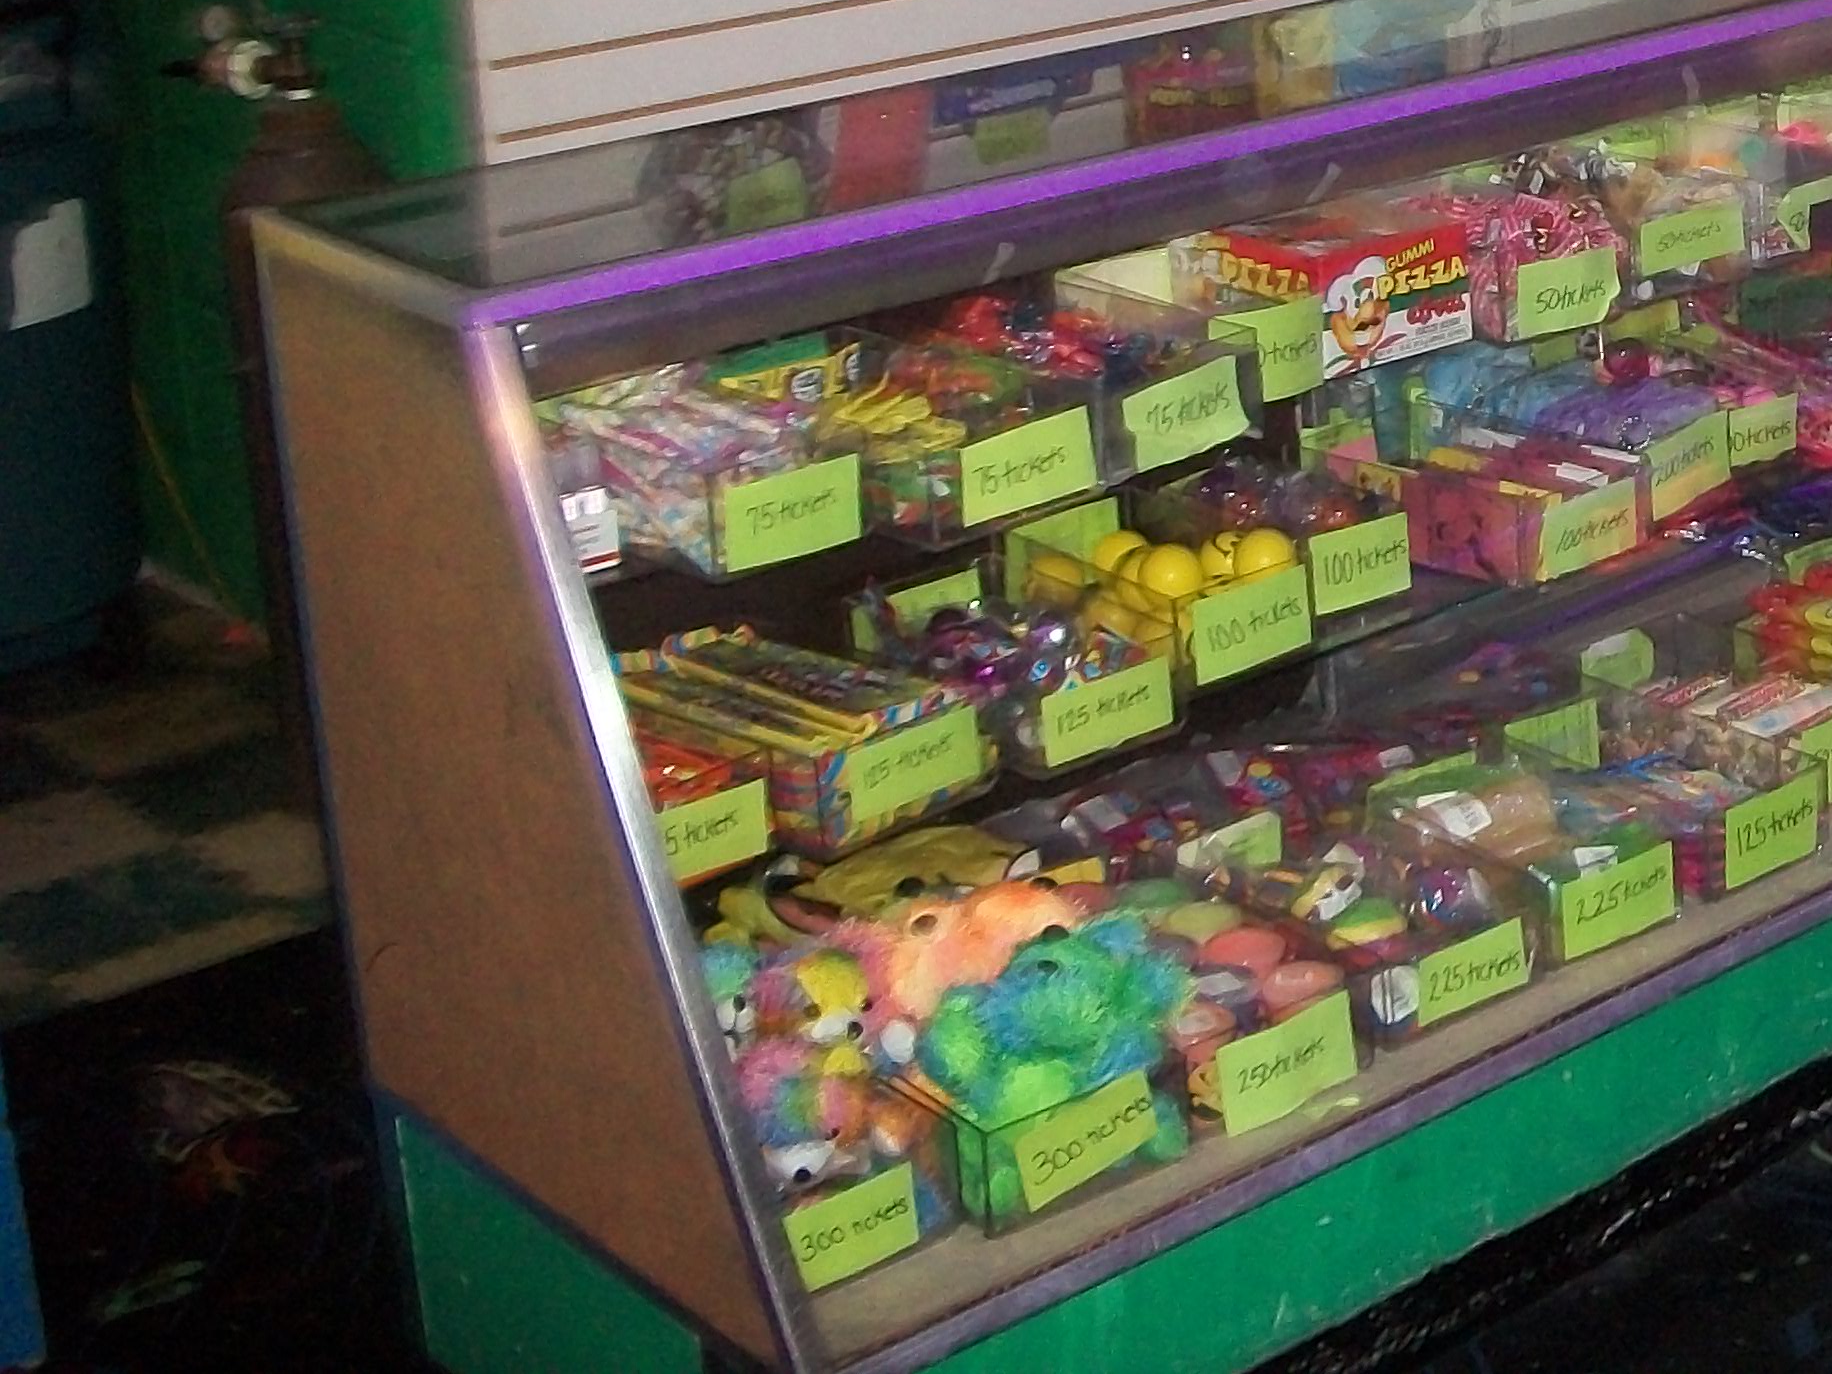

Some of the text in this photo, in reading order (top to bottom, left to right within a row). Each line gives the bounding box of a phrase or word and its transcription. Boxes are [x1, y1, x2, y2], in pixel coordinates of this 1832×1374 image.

[1385, 237, 1435, 273] GUMMI
[1376, 256, 1467, 301] PIZZA
[1536, 287, 1560, 315] 50
[1147, 405, 1174, 435] 75
[971, 465, 999, 496] 75
[745, 501, 775, 535] 75
[1324, 535, 1408, 586] 100 tickets
[1207, 619, 1245, 653] 100
[1735, 798, 1813, 858] 125 tickets
[1575, 881, 1622, 926] 225
[1429, 963, 1466, 1003] 225
[1238, 1059, 1269, 1095] 250
[1032, 1141, 1083, 1187] 300
[801, 1225, 845, 1263] 300
